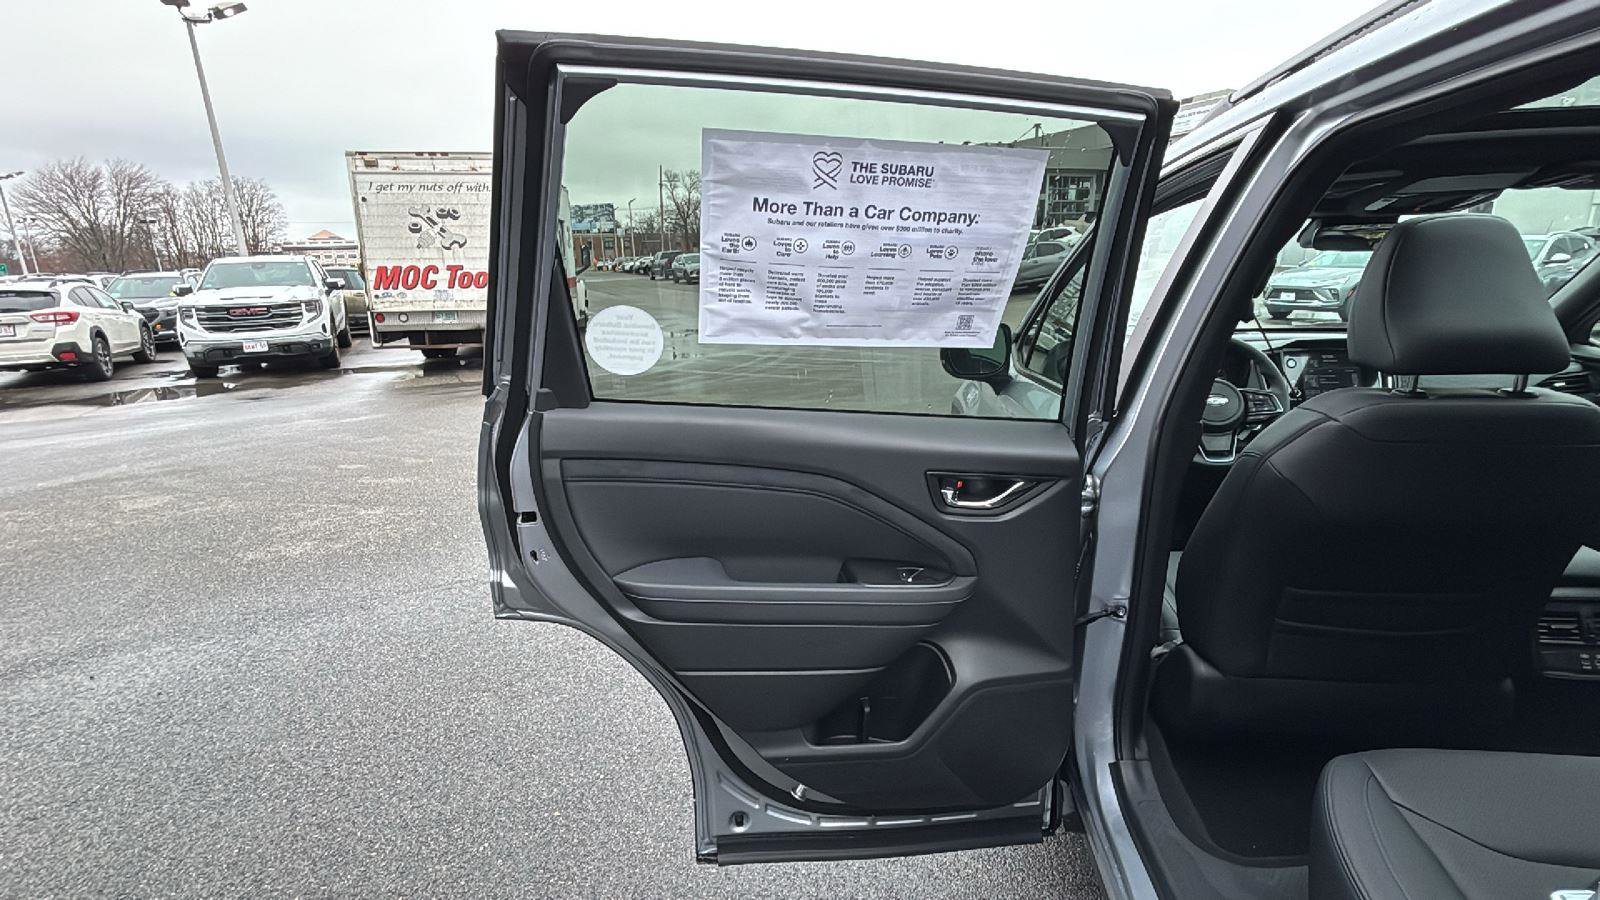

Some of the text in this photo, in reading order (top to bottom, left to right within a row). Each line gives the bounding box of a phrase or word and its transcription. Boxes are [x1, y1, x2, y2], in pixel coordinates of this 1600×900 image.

[851, 161, 935, 177] THE SUBARU
[850, 173, 880, 185] LOVE
[368, 182, 373, 192] I
[375, 183, 394, 194] get
[397, 185, 416, 194] my
[418, 184, 443, 192] nuts
[446, 182, 464, 194] off
[752, 197, 798, 215] More
[803, 201, 844, 217] Than
[848, 206, 859, 218] a
[864, 204, 895, 220] Car
[767, 218, 791, 226] Subaru
[861, 223, 879, 231] given
[373, 264, 439, 290] MOC
